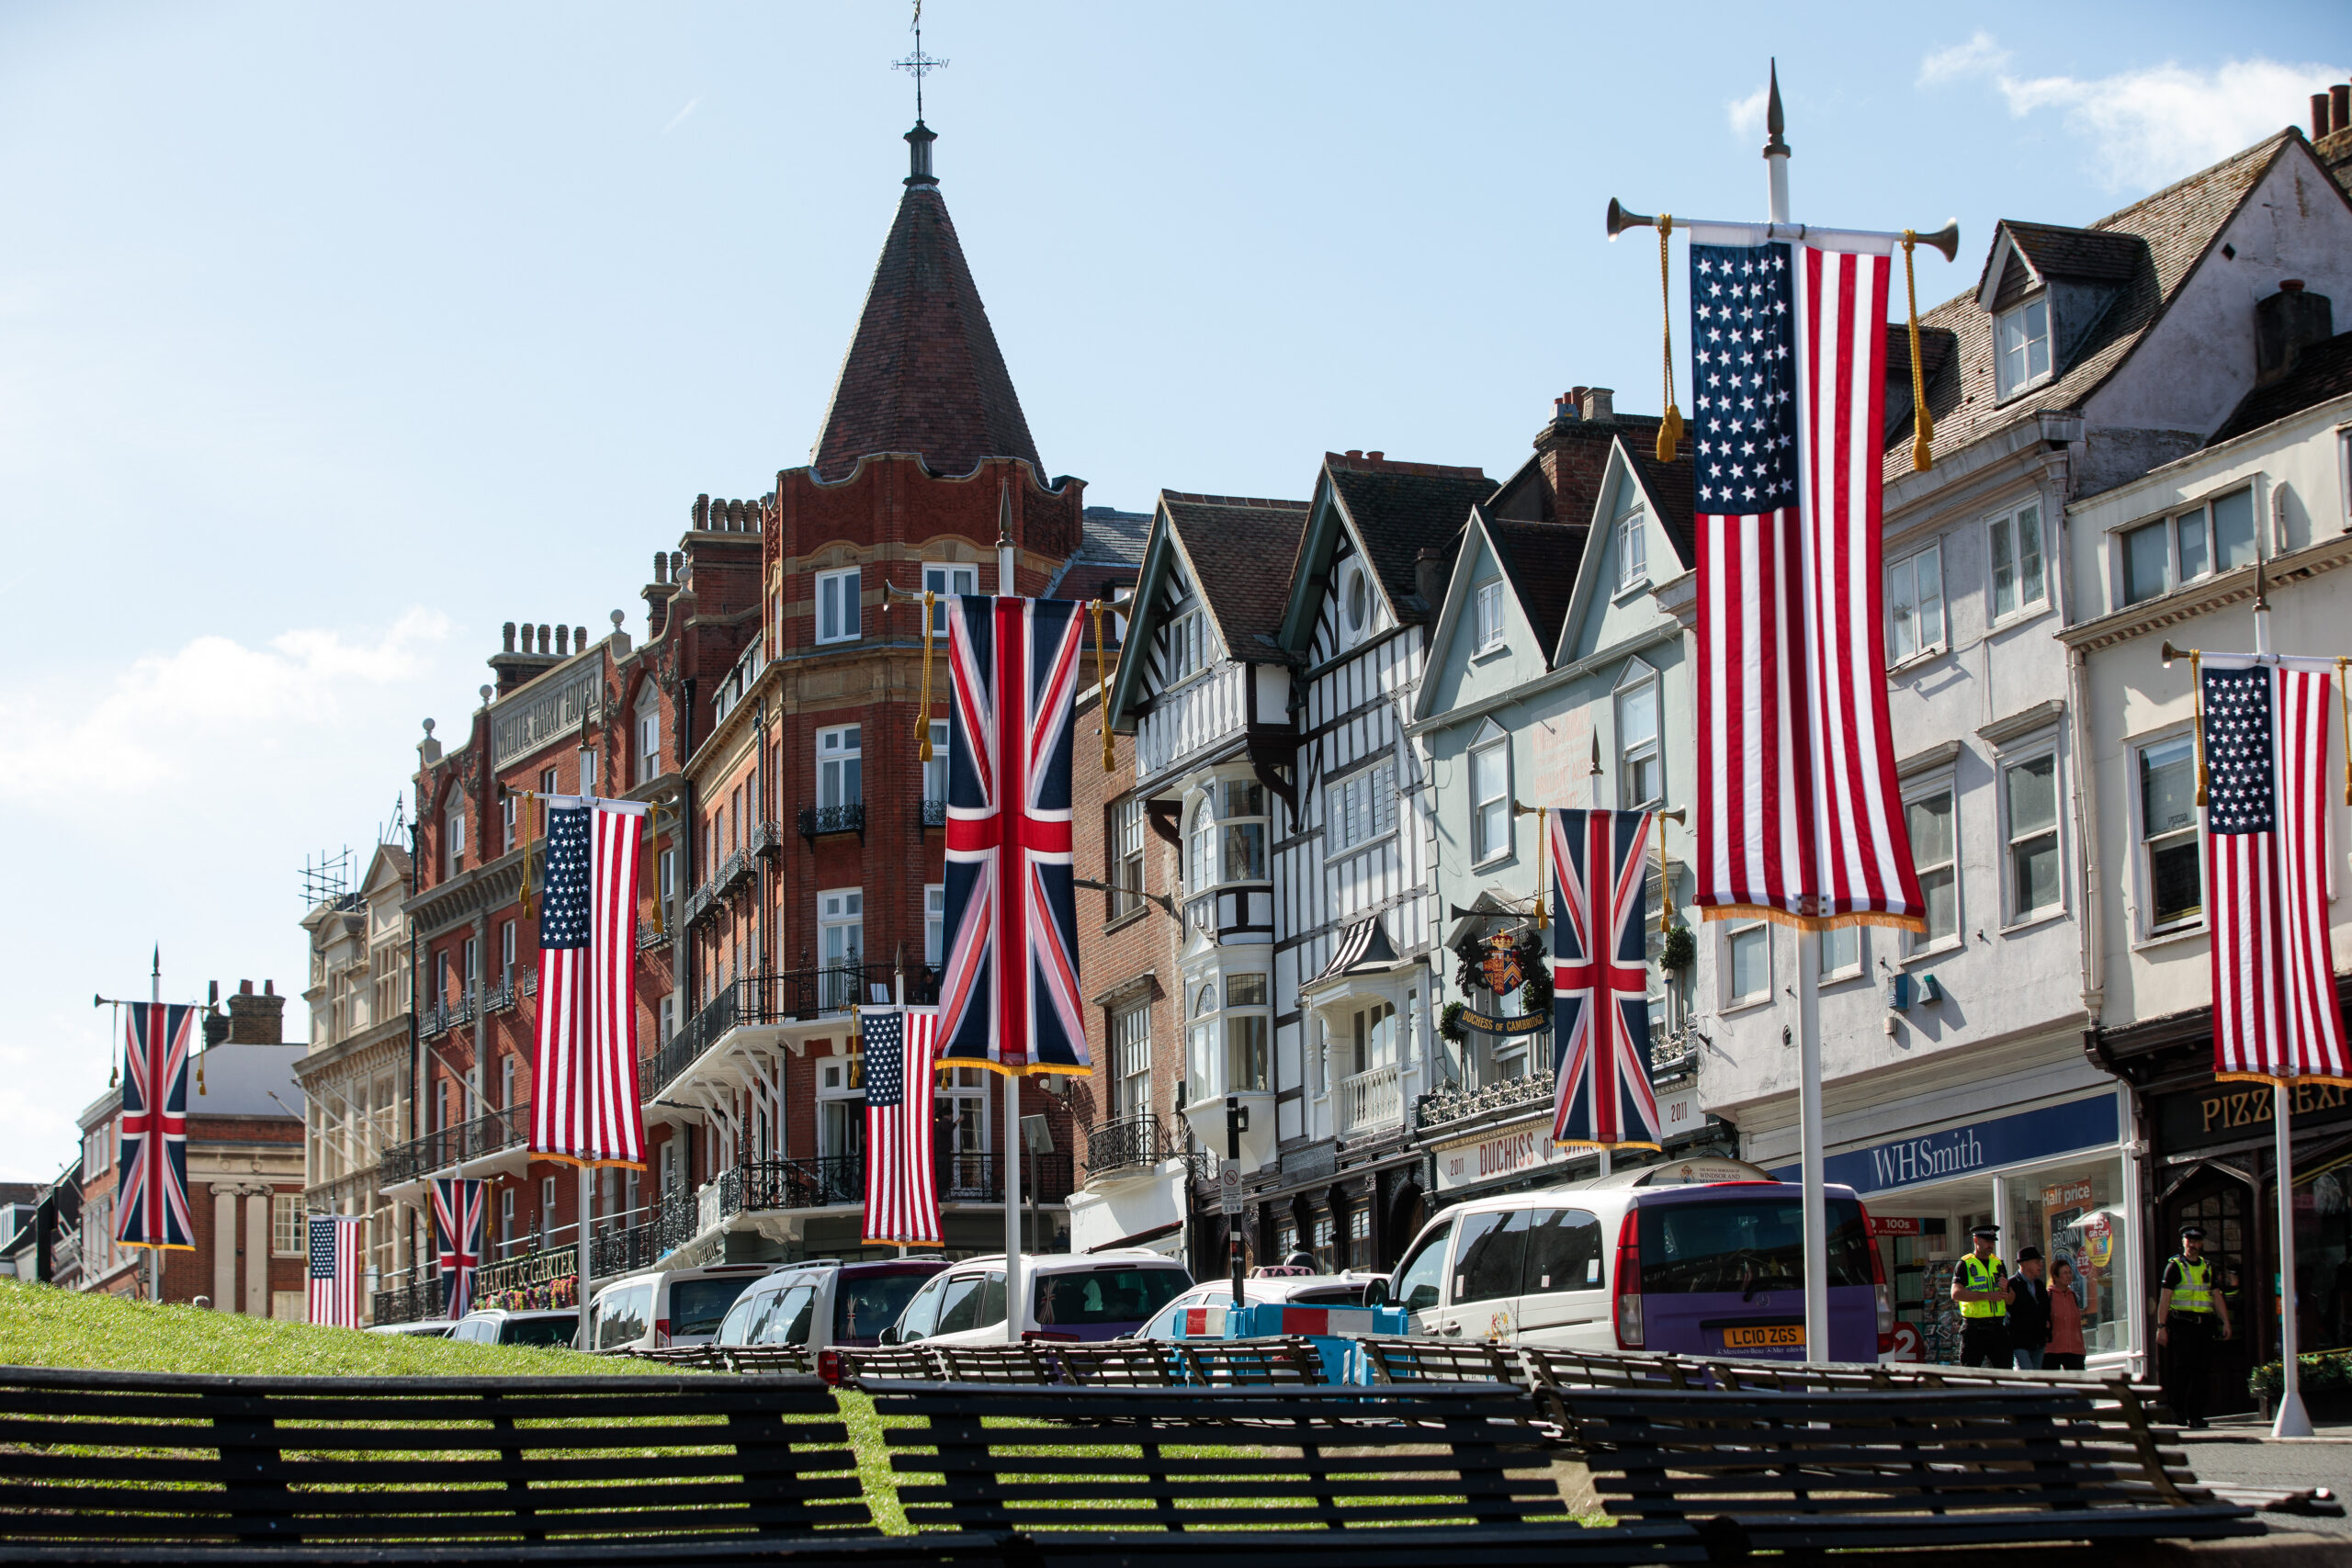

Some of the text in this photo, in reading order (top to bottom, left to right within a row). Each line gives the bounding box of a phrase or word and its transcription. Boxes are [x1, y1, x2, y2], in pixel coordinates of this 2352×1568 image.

[498, 671, 600, 760] WHITE HART HOTEL
[1462, 1010, 1545, 1032] DUCHESS OF CAMBRIDGE
[1670, 1100, 1689, 1122] 2011
[1450, 1157, 1464, 1177] 2011
[1479, 1131, 1535, 1178] DUCHESS
[1873, 1128, 1984, 1187] WHSmith
[2042, 1184, 2091, 1207] Half price
[1885, 1219, 1910, 1230] 100s
[2052, 1226, 2079, 1247] BROWN
[479, 1249, 577, 1296] HARTE & GARTER
[2077, 1256, 2089, 1267] £12
[1264, 1269, 1310, 1277] TAXI
[1733, 1328, 1796, 1345] LC10 ZGS
